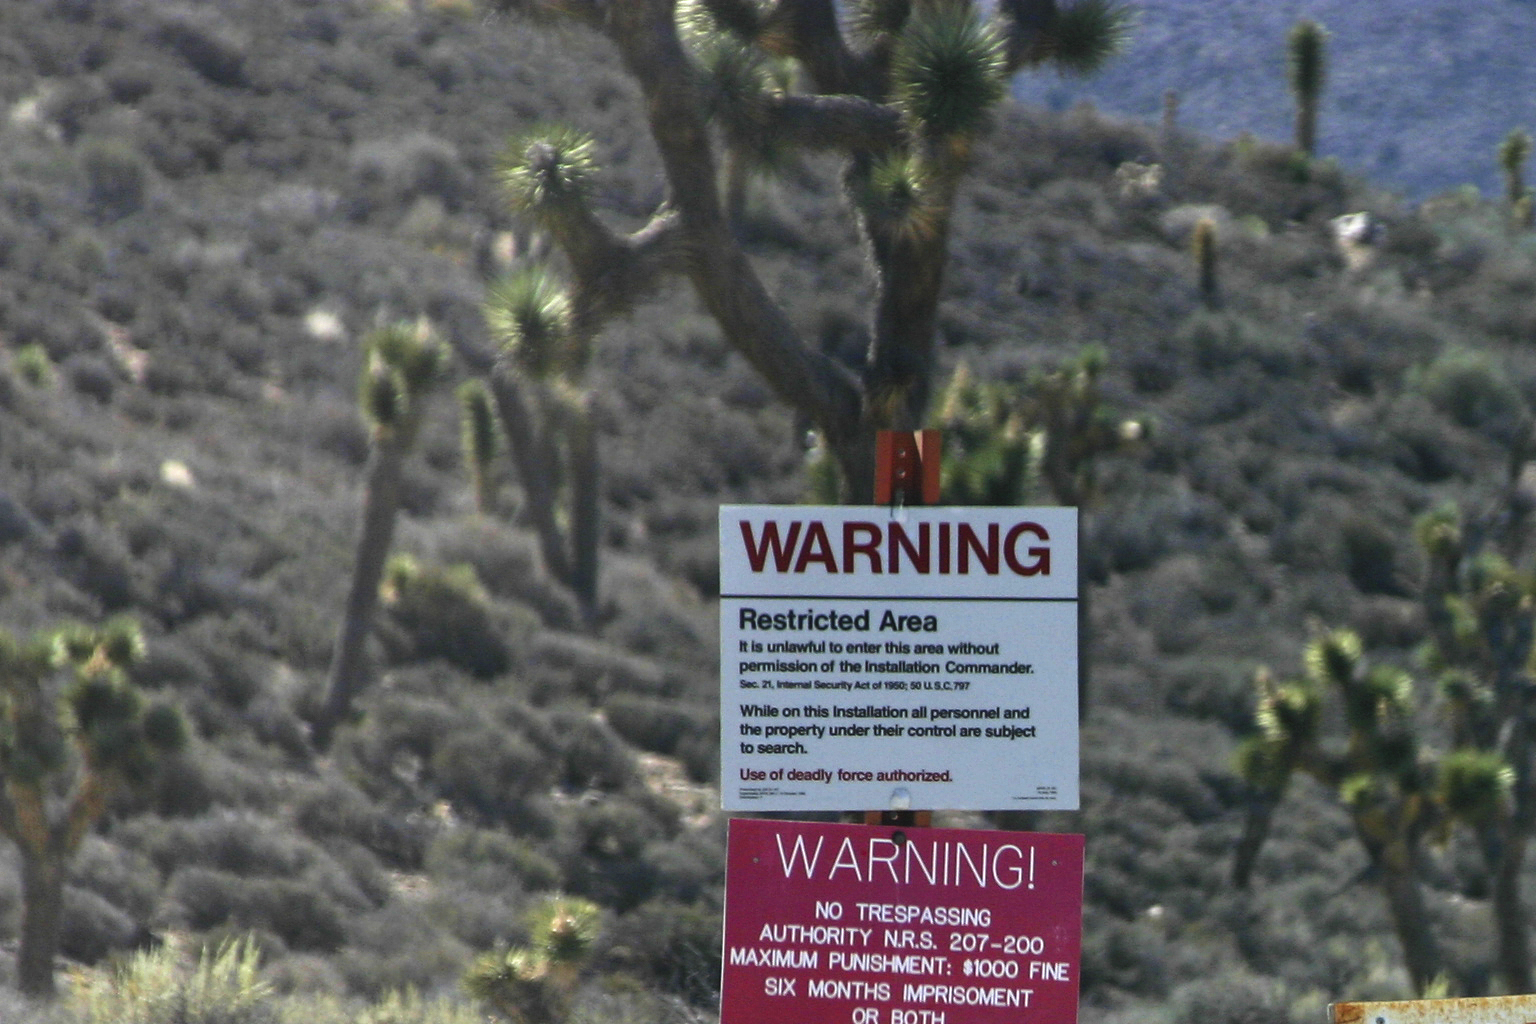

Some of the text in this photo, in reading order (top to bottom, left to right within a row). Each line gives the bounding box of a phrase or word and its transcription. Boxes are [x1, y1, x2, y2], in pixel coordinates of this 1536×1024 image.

[740, 521, 1050, 576] WARNING
[740, 608, 937, 632] Restricted Area
[739, 640, 999, 655] It is unlawful to enter this area without
[739, 659, 1034, 675] permission of the Installation Commander.
[740, 679, 759, 689] Sec.
[762, 680, 774, 689] 21,
[777, 680, 812, 689] Internal
[814, 680, 853, 691] Security
[854, 681, 870, 690] Act
[872, 681, 882, 690] of
[884, 681, 908, 691] 1950;
[910, 681, 922, 690] 50
[740, 705, 1030, 721] While on this Installation all personnel and
[740, 724, 1036, 740] the property under their control are subject
[740, 742, 807, 754] to search.
[740, 768, 952, 784] Use of deadly force authorized.
[776, 834, 1034, 889] WARNING!
[816, 901, 991, 927] NO TRESPASSING
[759, 924, 1044, 954] AUTHORITY N.R.S. 207-200
[730, 947, 1069, 981] MAXIMUM PUNISHMENT: $1000 FINE
[765, 977, 1033, 1007] SIX MONTHS IMPRISOMENT
